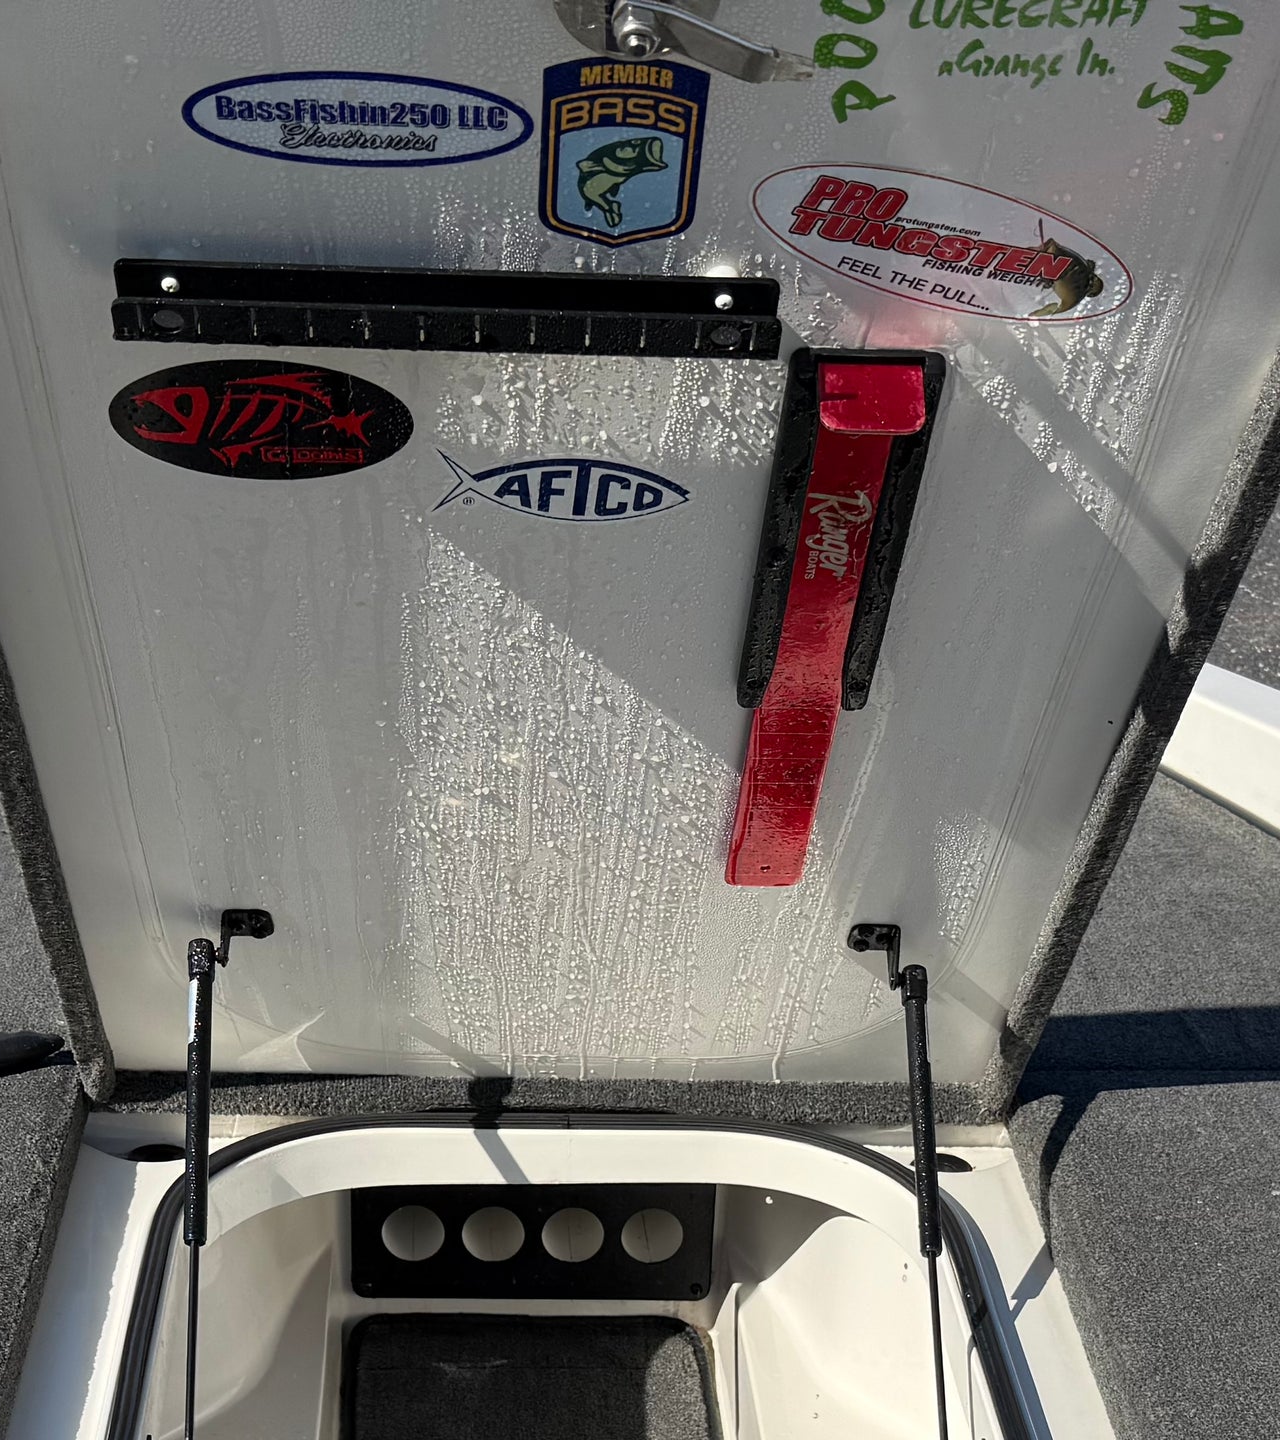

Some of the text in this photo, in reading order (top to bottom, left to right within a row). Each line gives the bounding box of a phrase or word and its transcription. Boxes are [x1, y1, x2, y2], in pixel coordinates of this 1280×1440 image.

[579, 64, 674, 89] MEMBER
[215, 95, 509, 131] BassFishin250 LLC
[560, 97, 686, 133] BASS
[279, 122, 438, 151] Electronics
[799, 175, 908, 221] PRO
[788, 207, 1073, 281] TUNGSTEN
[894, 215, 982, 238] protungsten.com
[837, 255, 991, 312] FEEL THE PULL...
[922, 258, 1055, 290] FISHING WEIGHTS
[493, 463, 664, 517] AFTCO
[805, 490, 872, 580] Ranger
[804, 551, 820, 580] BOATS
